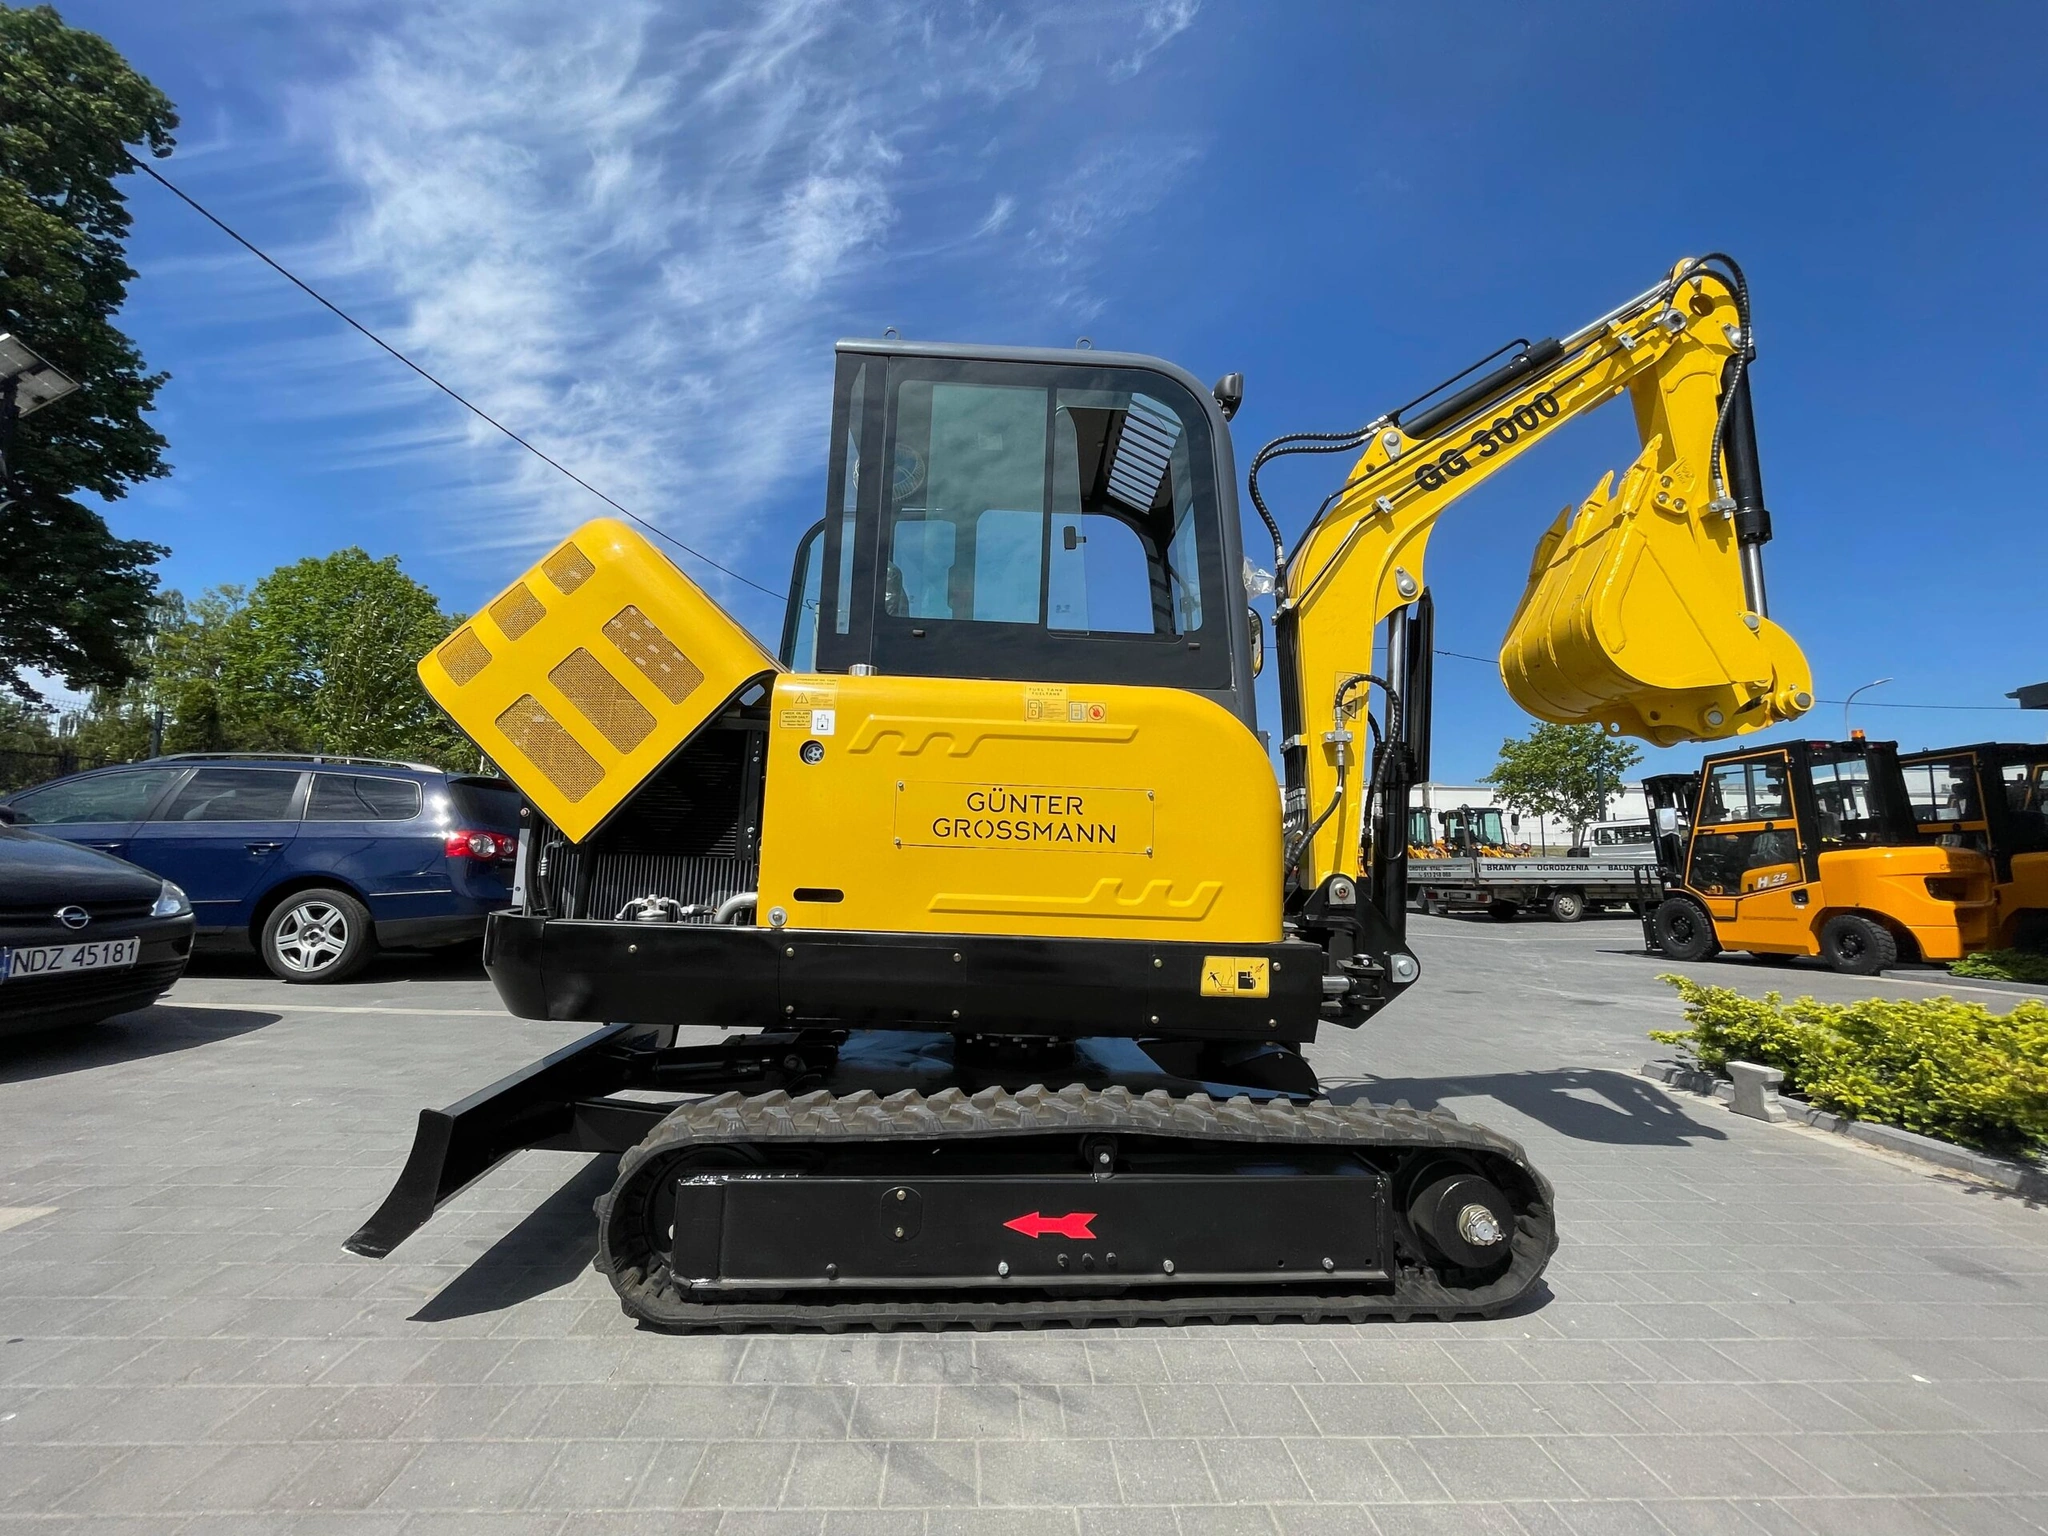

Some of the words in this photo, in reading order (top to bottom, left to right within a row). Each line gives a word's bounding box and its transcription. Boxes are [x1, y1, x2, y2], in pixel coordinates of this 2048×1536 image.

[1414, 448, 1473, 492] GG
[1471, 391, 1560, 458] 3000
[966, 787, 1084, 816] GÜNTER
[932, 817, 1117, 844] GROSSMANN
[1757, 876, 1769, 889] H
[1772, 872, 1788, 883] 25
[12, 947, 65, 975] NDZ
[71, 940, 136, 967] 45181
